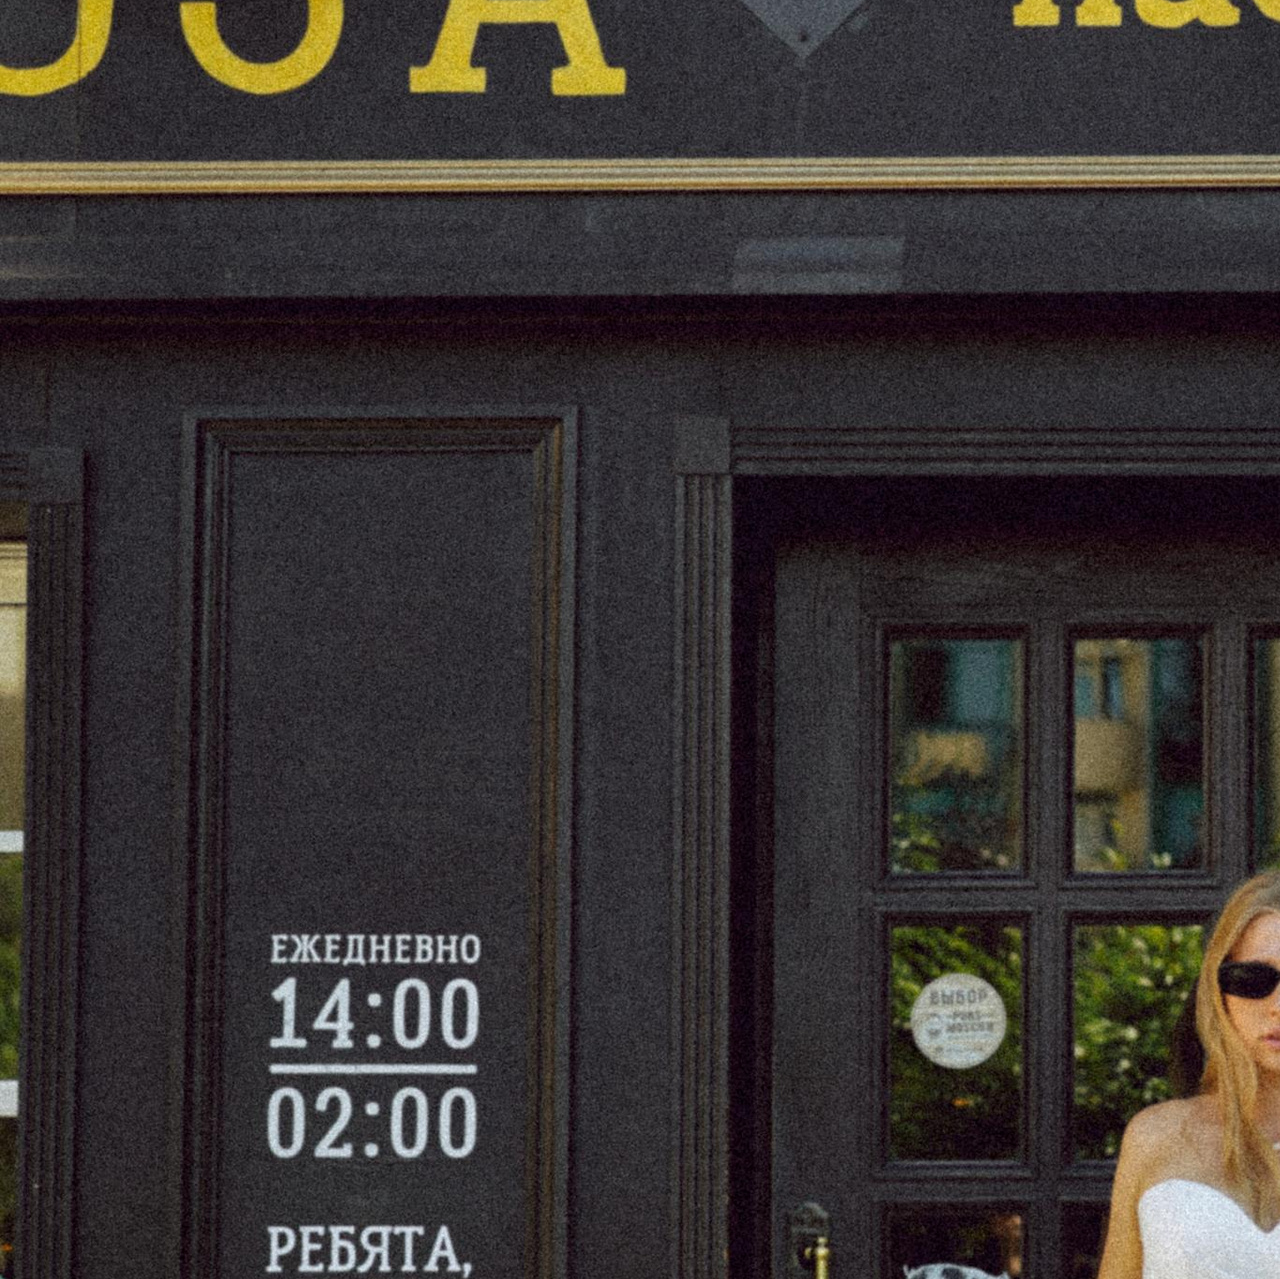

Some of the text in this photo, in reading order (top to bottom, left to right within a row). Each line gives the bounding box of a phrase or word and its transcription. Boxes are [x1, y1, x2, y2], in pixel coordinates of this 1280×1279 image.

[270, 933, 482, 966] ЕЖЕДНЕВНО
[269, 976, 480, 1050] 14:00
[267, 1086, 477, 1159] 02:00
[265, 1224, 473, 1279] РЕБЯТА,
